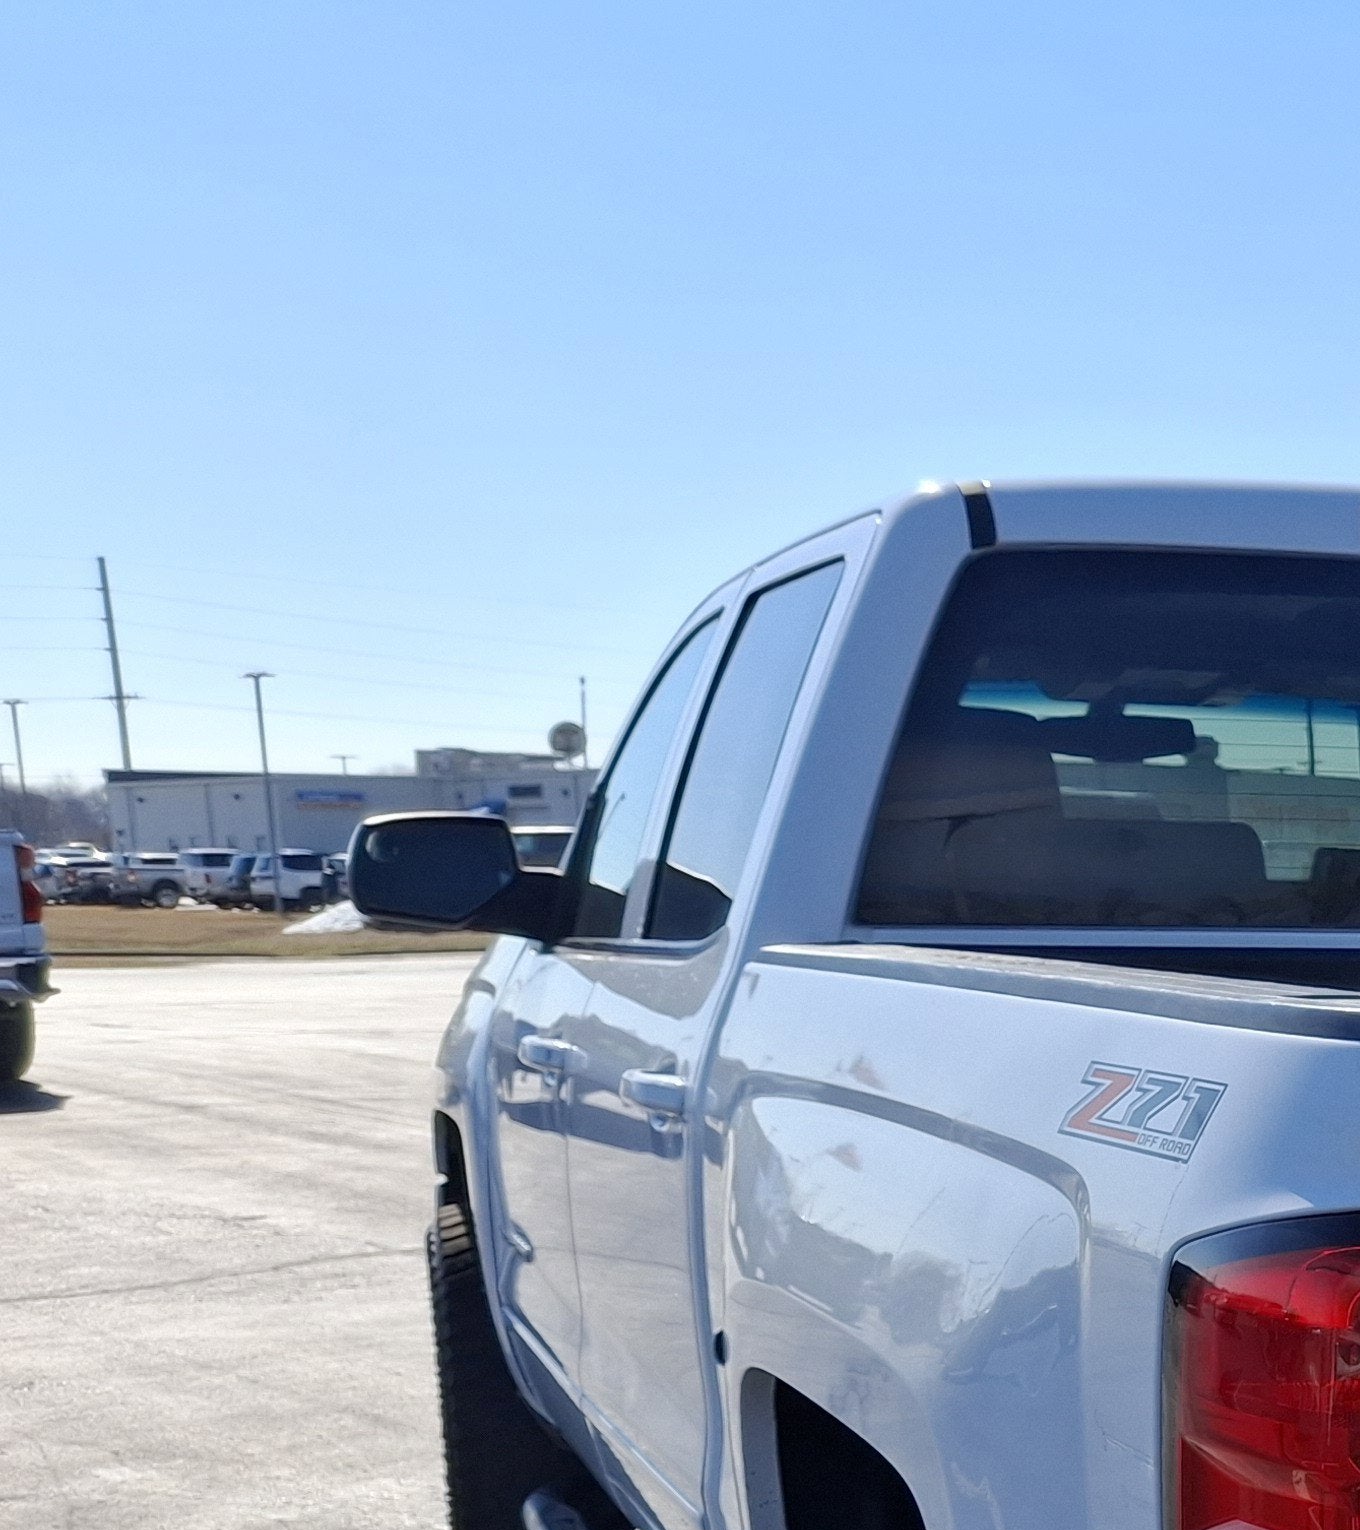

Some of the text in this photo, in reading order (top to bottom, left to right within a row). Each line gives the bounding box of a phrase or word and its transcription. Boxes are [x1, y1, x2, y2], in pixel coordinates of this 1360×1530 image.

[1057, 1060, 1229, 1164] Z71
[1137, 1134, 1193, 1156] OFF ROAD
